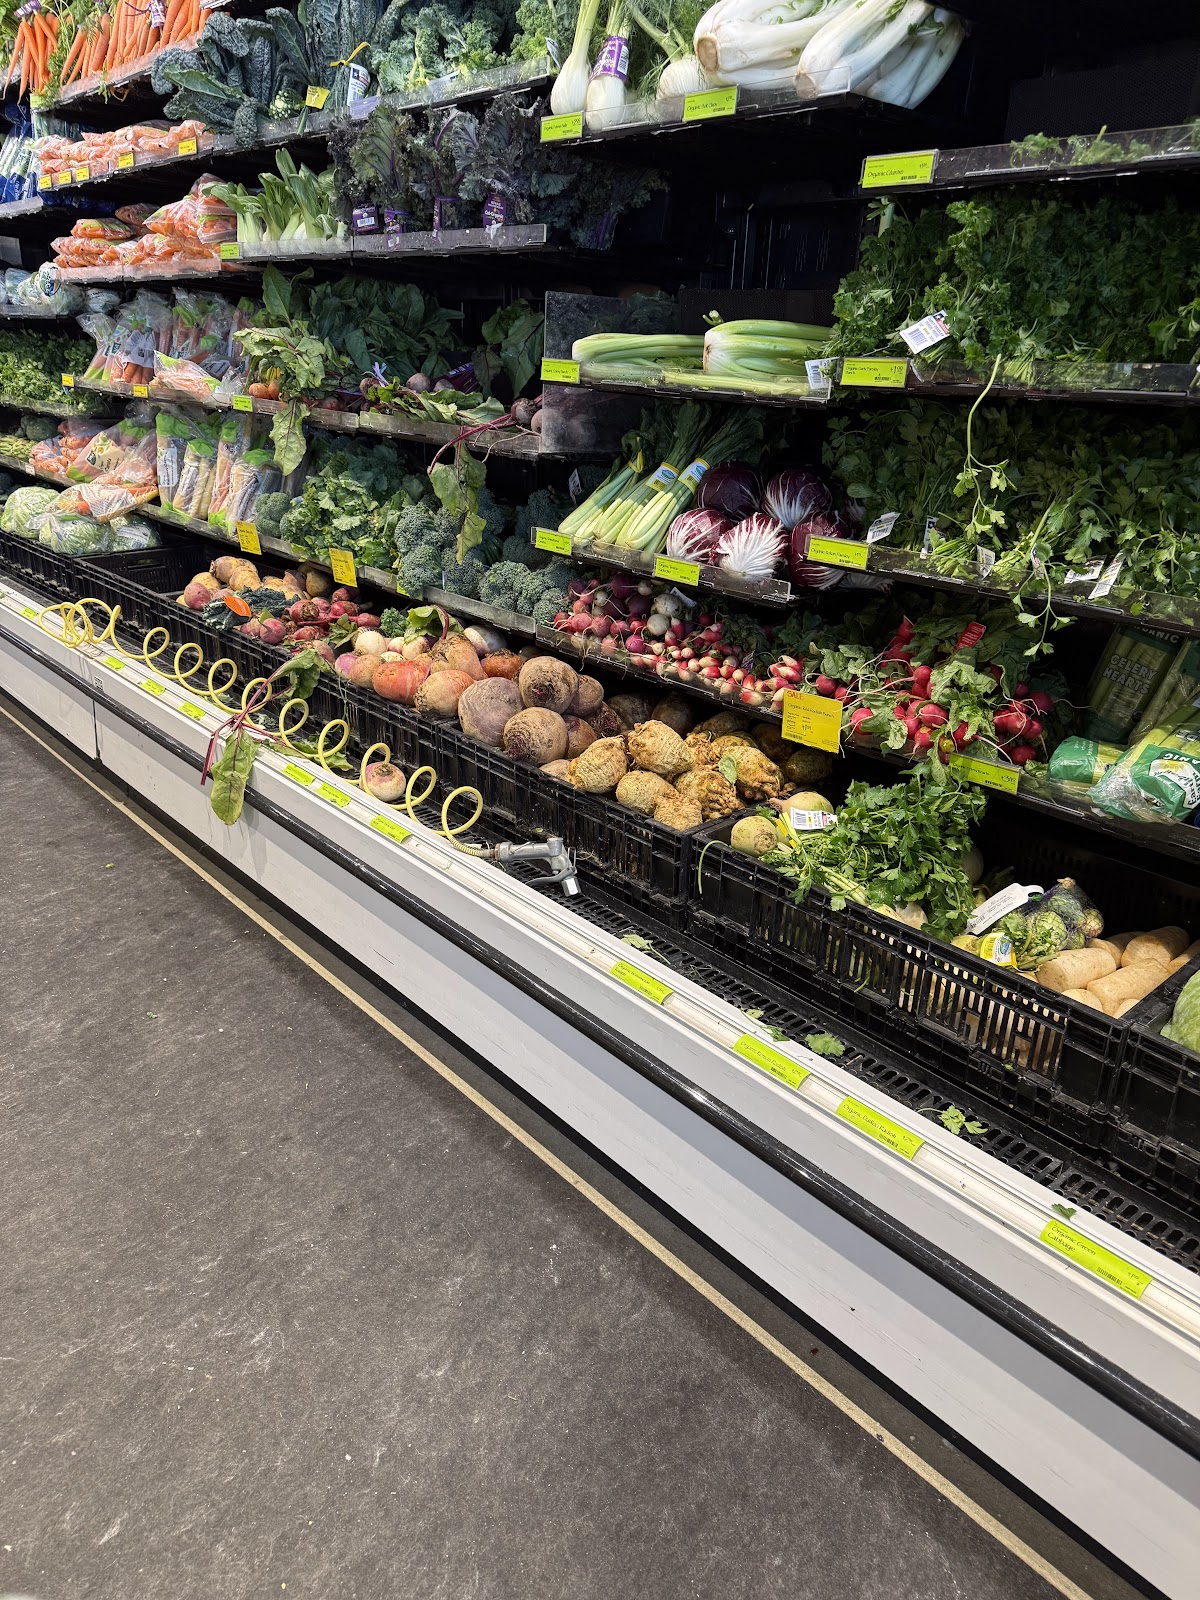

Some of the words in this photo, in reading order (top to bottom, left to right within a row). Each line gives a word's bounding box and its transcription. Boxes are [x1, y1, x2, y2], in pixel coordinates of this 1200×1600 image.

[867, 171, 885, 179] Organic
[811, 547, 825, 555] Organic
[1110, 654, 1157, 681] CELERY
[1103, 667, 1150, 694] HEARTS
[787, 691, 804, 701] SALE
[1163, 753, 1200, 766] ANIC
[740, 1041, 757, 1054] Organic
[843, 1104, 863, 1119] Organic
[879, 1124, 897, 1139] Radish
[1047, 1232, 1077, 1253] Cabbage
[1051, 1226, 1077, 1244] Organic
[1076, 1241, 1097, 1256] Green
